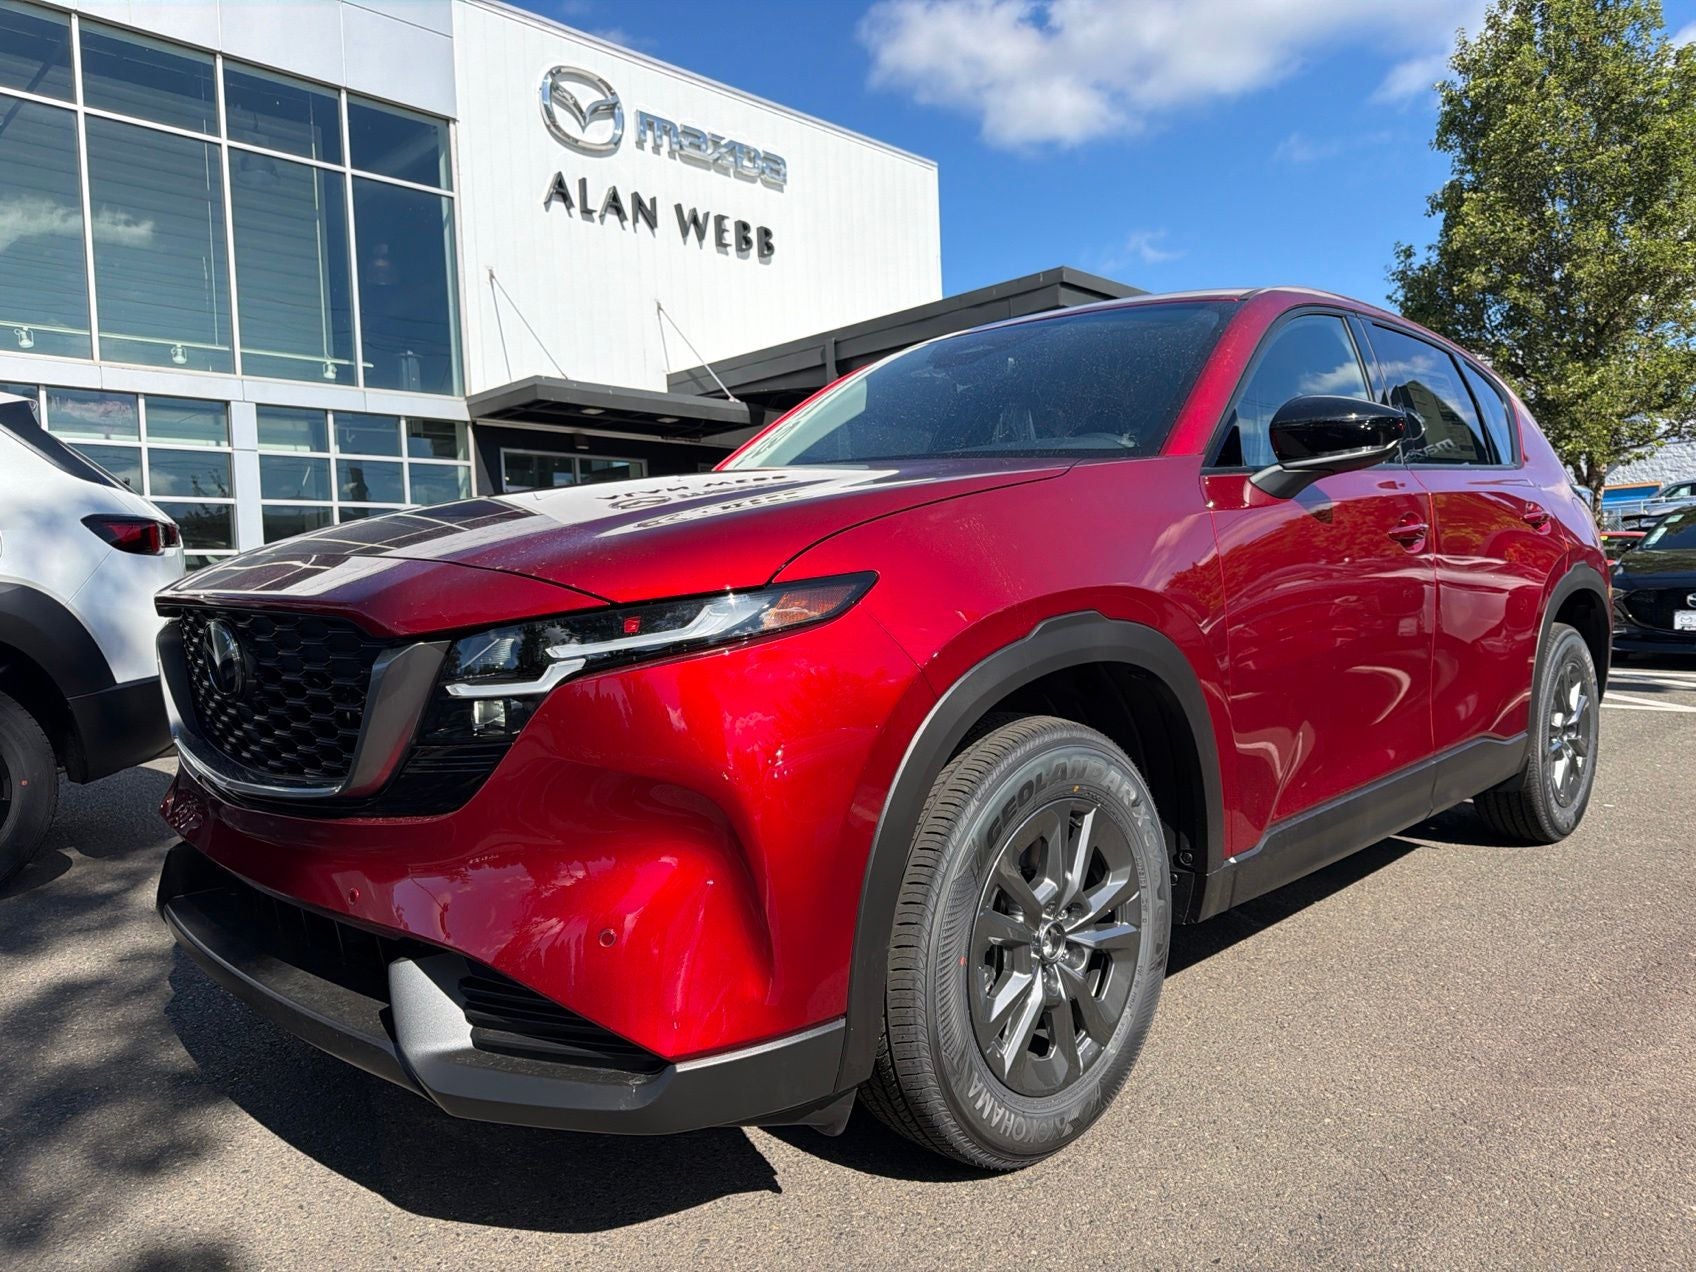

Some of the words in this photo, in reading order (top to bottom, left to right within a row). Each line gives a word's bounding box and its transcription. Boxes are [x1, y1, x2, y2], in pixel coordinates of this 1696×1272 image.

[544, 171, 658, 234] ALAN
[674, 203, 775, 260] WEBB
[967, 1071, 1058, 1144] YOKOHAMA
